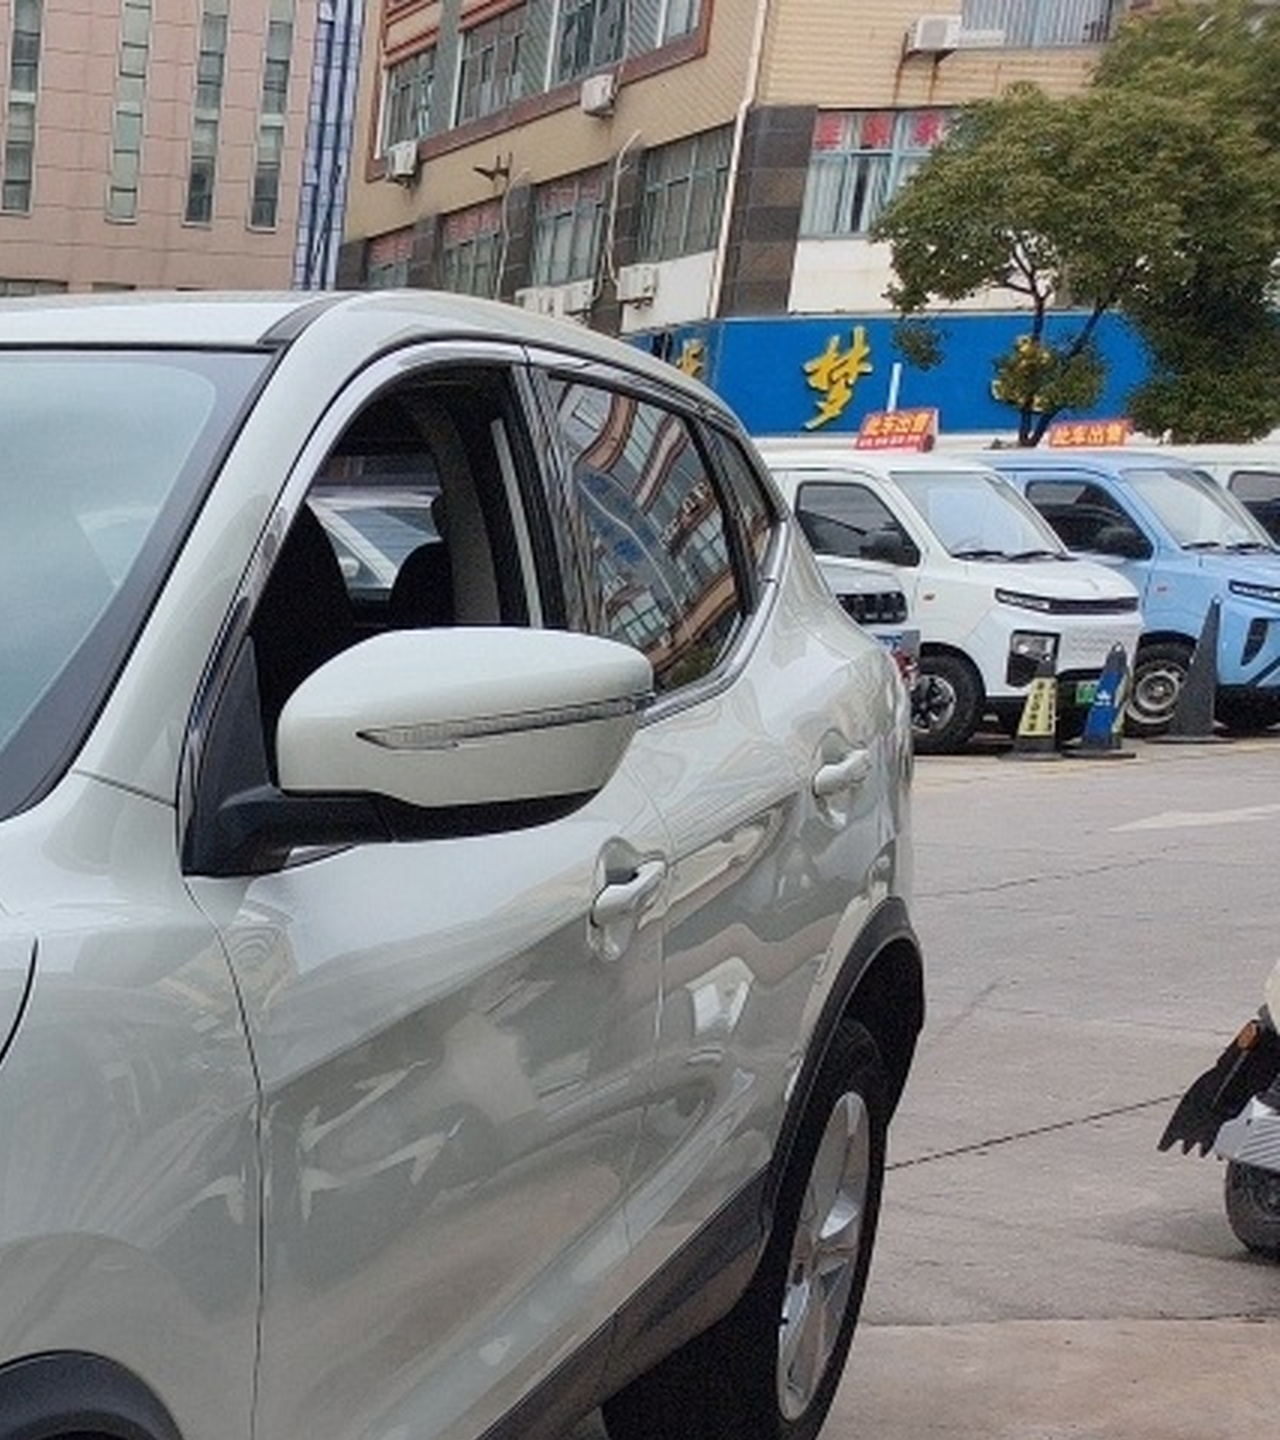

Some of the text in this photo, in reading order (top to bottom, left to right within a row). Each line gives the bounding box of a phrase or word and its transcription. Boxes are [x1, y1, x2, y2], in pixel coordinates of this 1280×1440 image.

[803, 325, 873, 429] 梦
[862, 412, 931, 437] 此车出售
[1051, 422, 1123, 446] 此车出售
